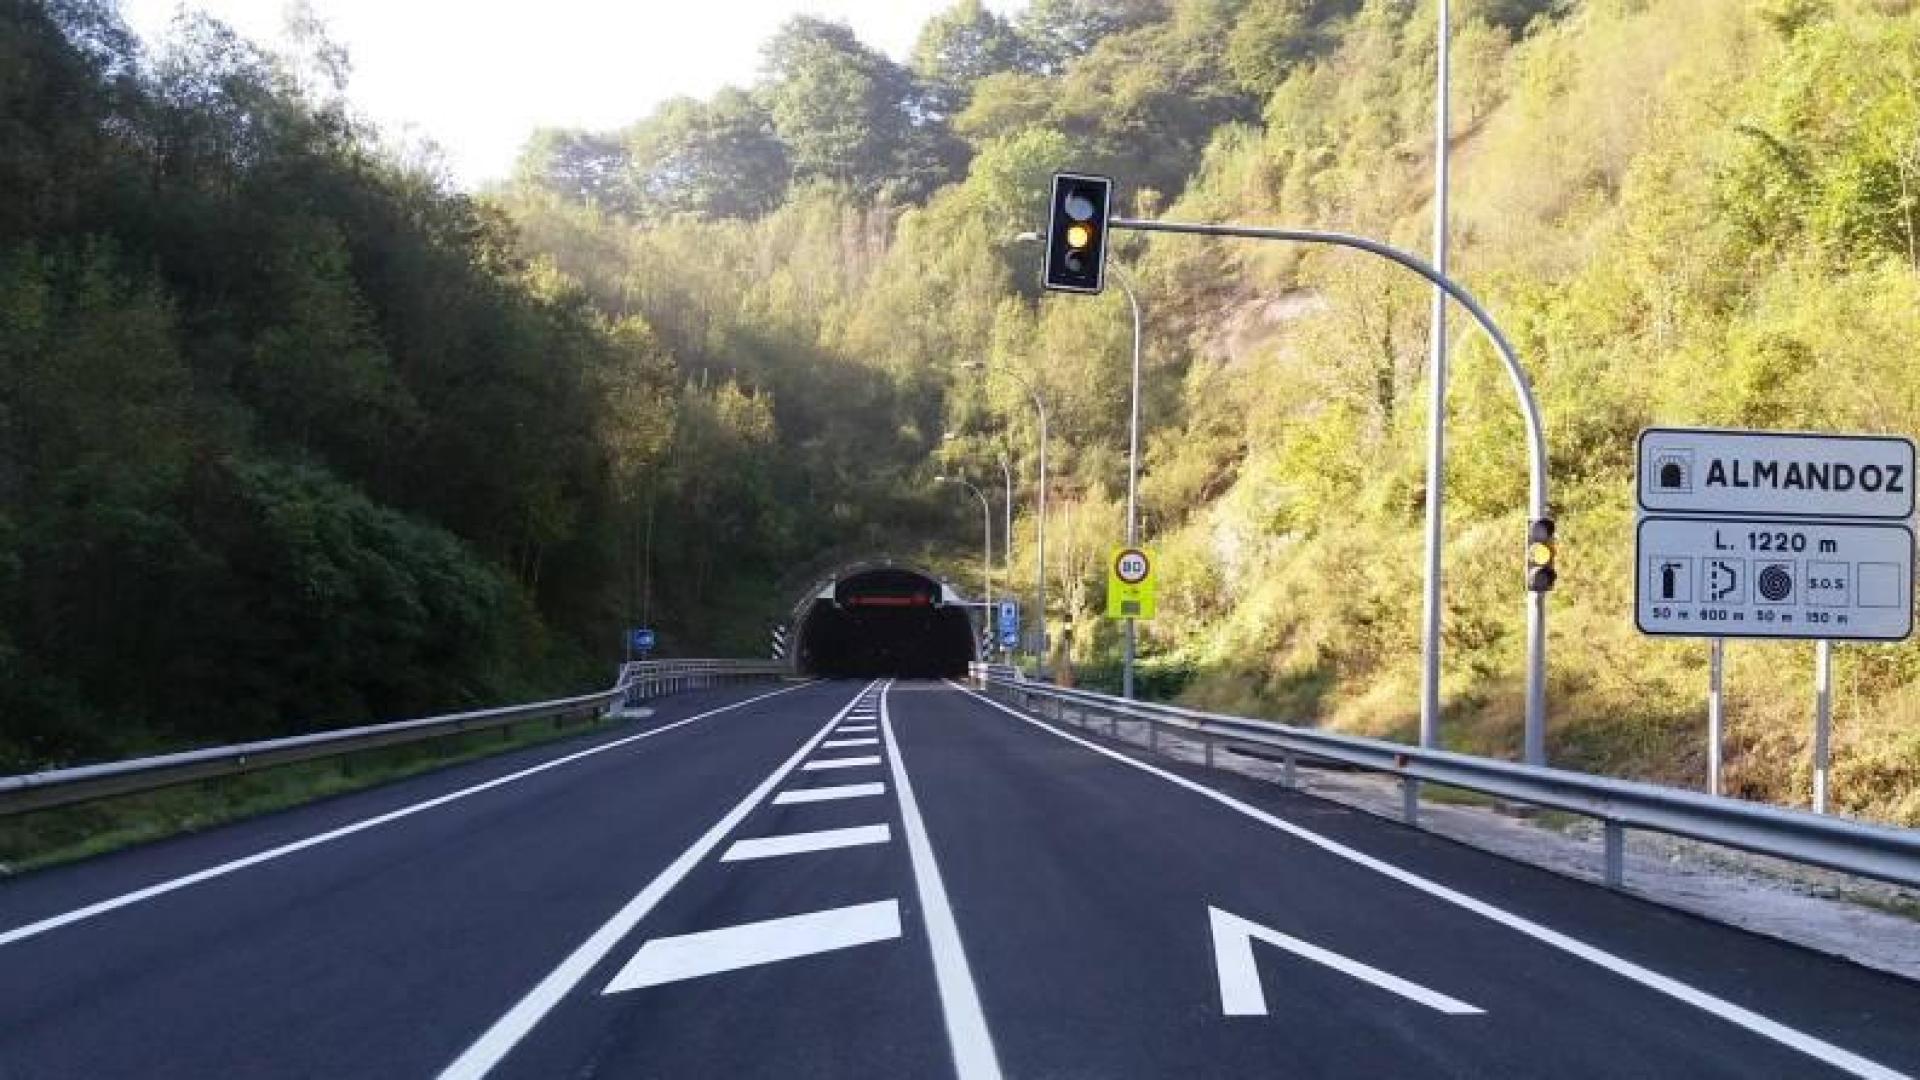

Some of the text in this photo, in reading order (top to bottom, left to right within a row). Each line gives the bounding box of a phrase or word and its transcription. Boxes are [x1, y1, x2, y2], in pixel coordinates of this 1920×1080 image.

[1705, 458, 1904, 493] ALMANDOZ
[1715, 529, 1838, 553] L. 1220 m
